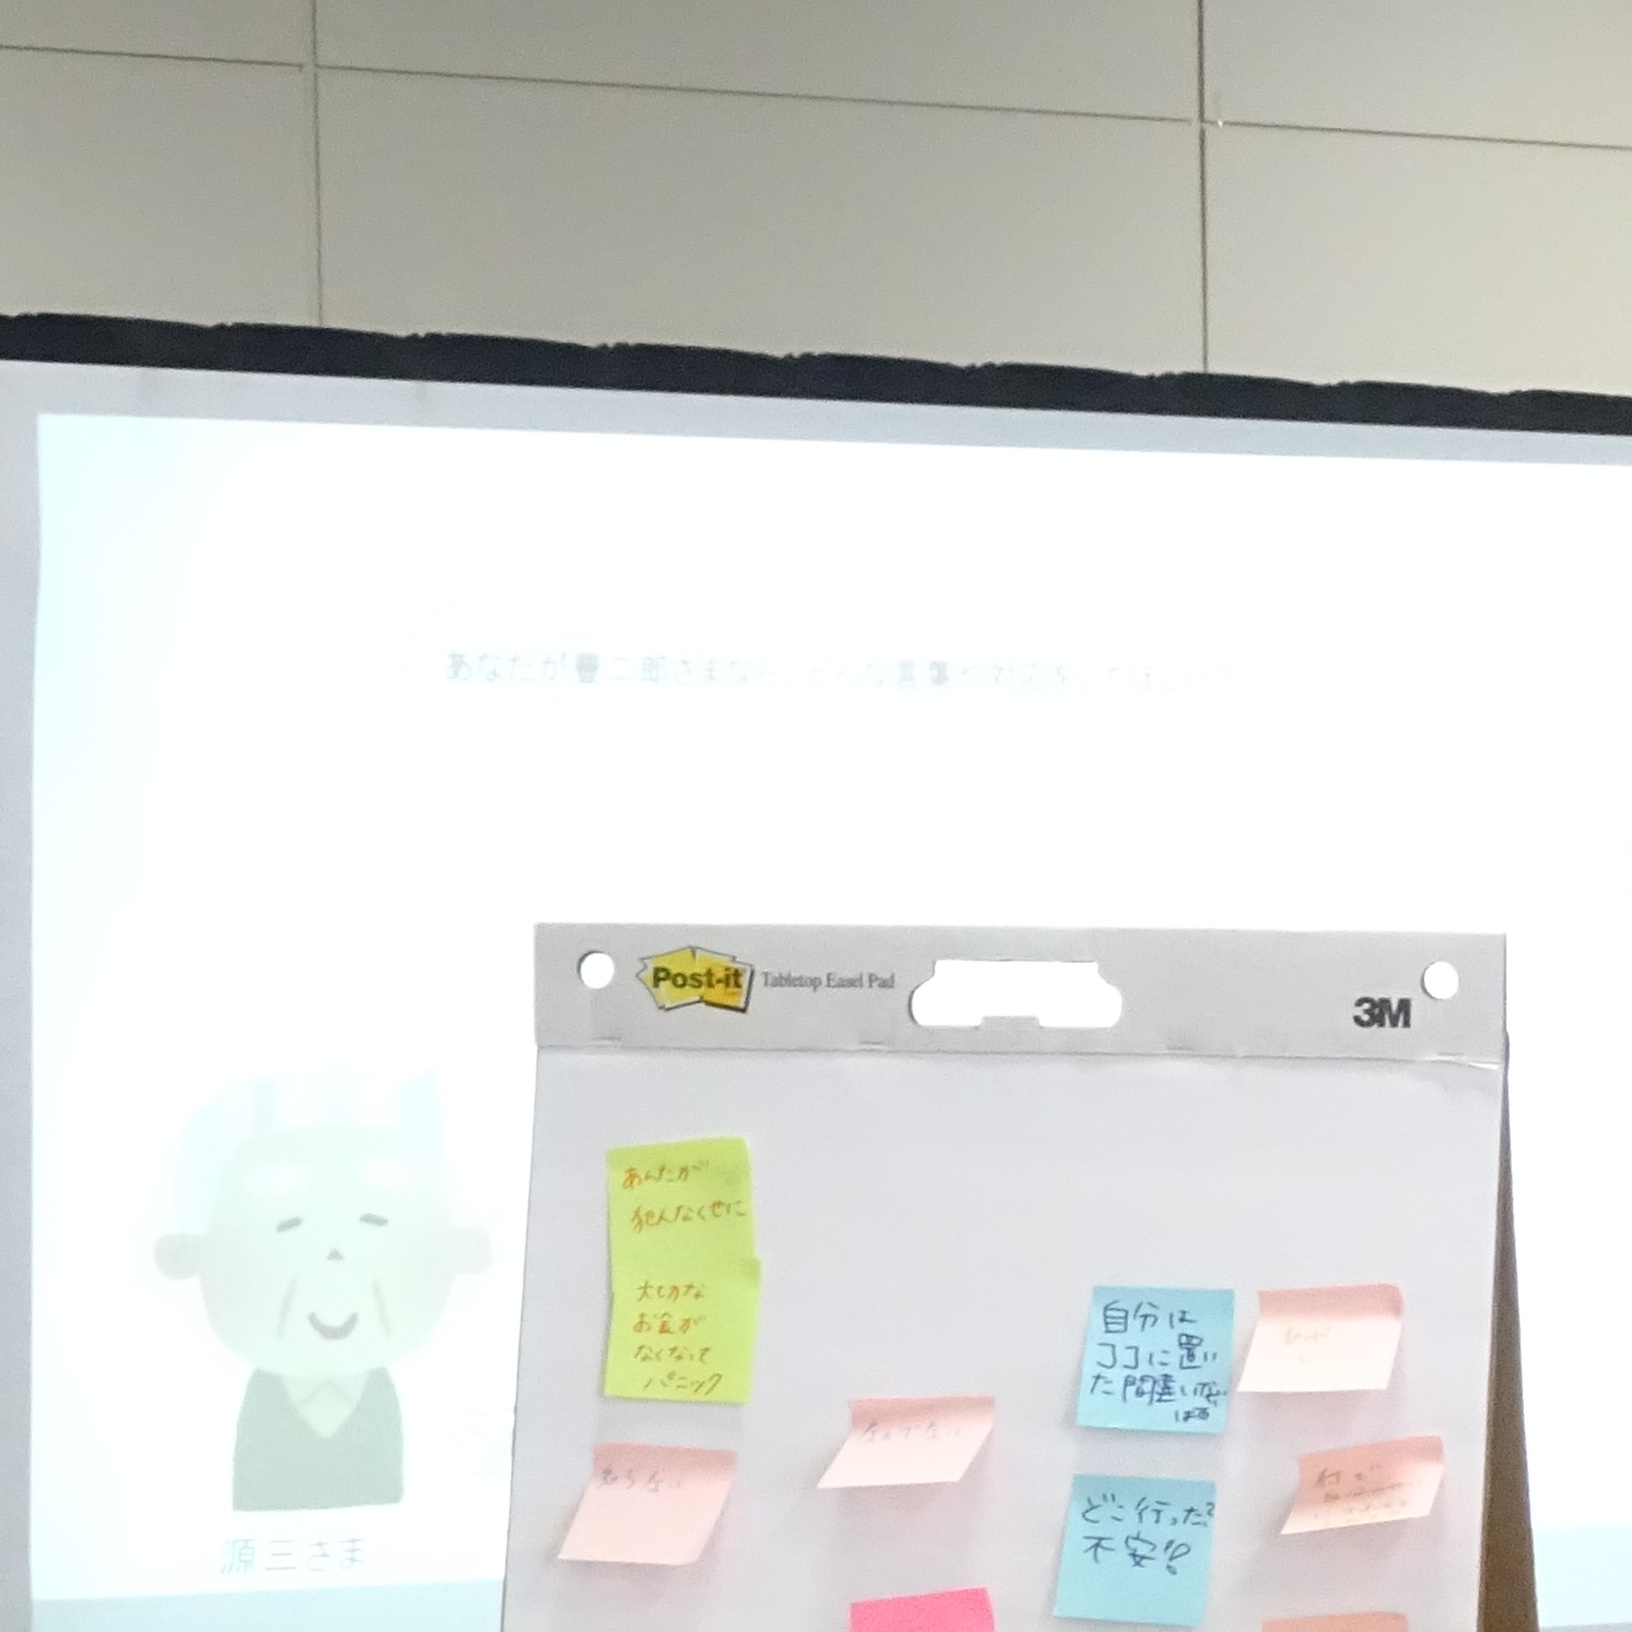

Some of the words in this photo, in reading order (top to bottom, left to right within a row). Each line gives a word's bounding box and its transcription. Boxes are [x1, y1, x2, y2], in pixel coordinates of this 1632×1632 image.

[652, 967, 743, 990] Post-it
[762, 972, 822, 992] Tabletop
[826, 973, 864, 988] Easel
[868, 972, 896, 989] Pad
[1353, 996, 1412, 1028] 3M
[1102, 1300, 1198, 1334] 自分は
[220, 1535, 367, 1575] 源三さま
